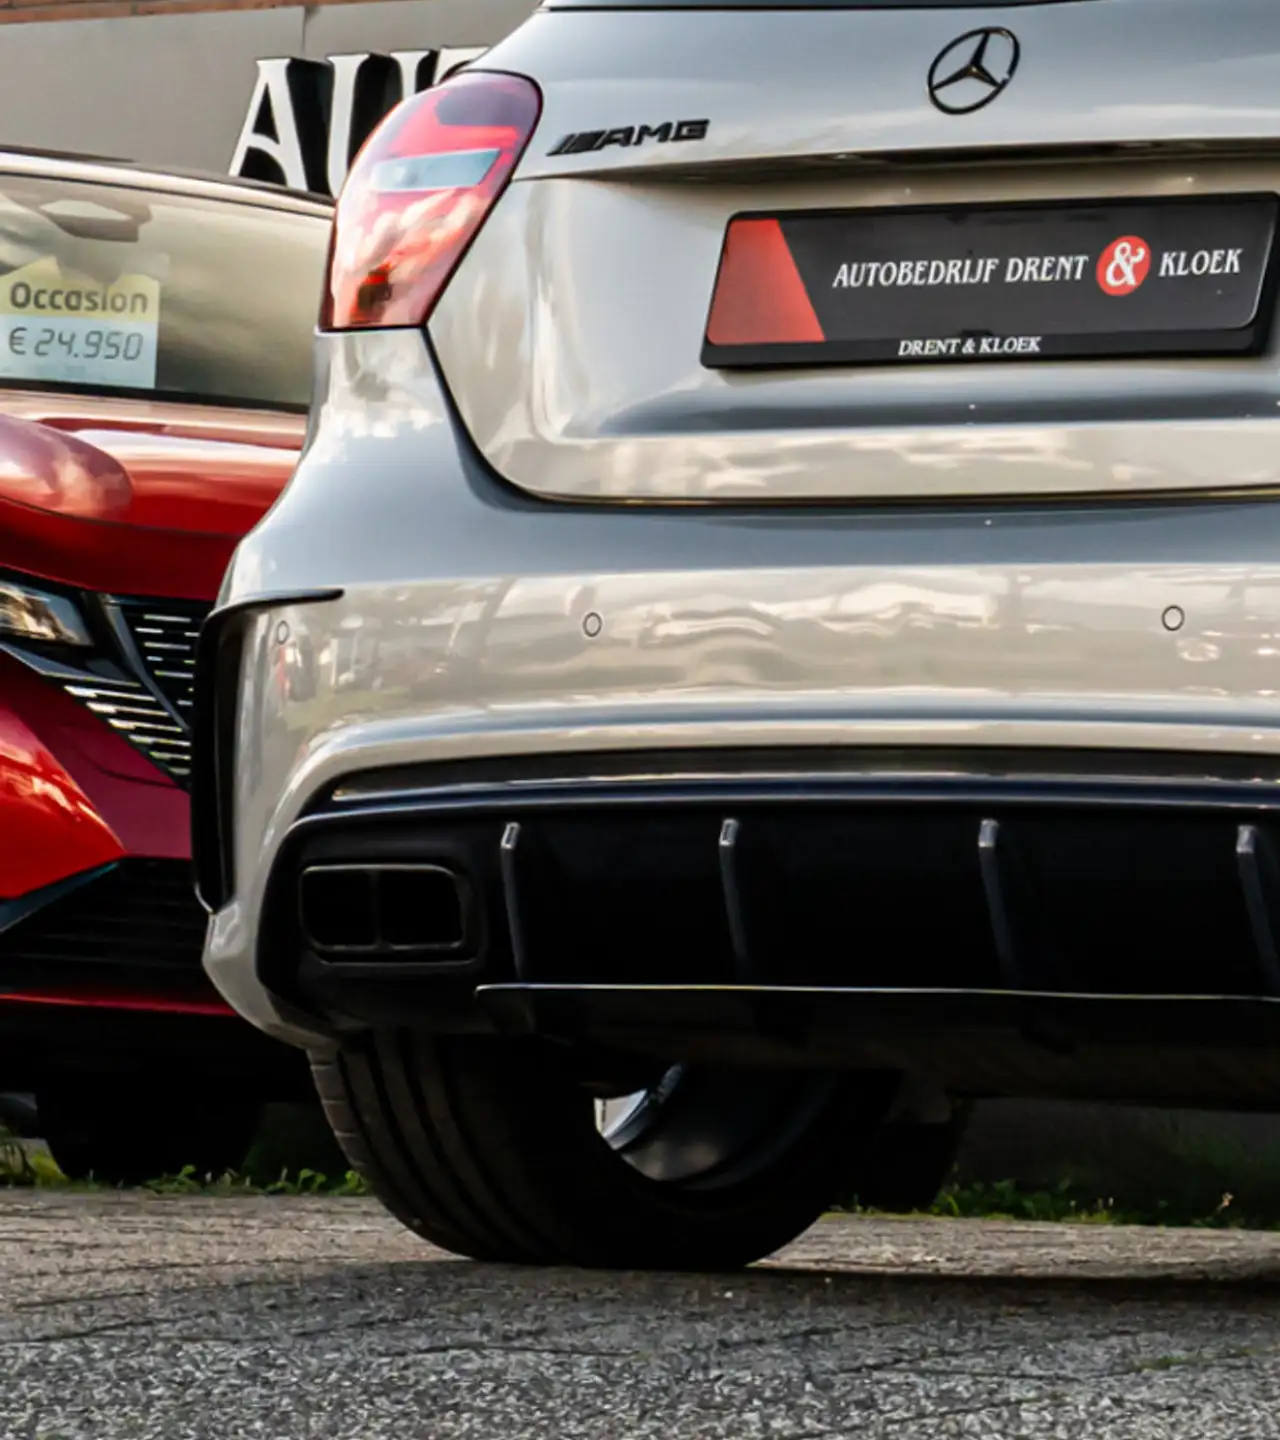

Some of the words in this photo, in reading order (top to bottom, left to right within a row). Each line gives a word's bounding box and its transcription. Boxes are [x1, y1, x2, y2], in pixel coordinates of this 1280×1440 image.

[585, 118, 711, 152] AMG
[832, 257, 999, 288] AUTOBEDRIJF
[1004, 254, 1090, 283] DRENT
[1105, 241, 1145, 288] &
[1158, 247, 1244, 277] KLOEK
[9, 281, 149, 313] Occasion
[8, 326, 28, 356] €
[33, 327, 145, 361] 24.950
[898, 339, 960, 356] DRENT
[961, 339, 976, 354] &
[979, 336, 1042, 353] KLOEK
